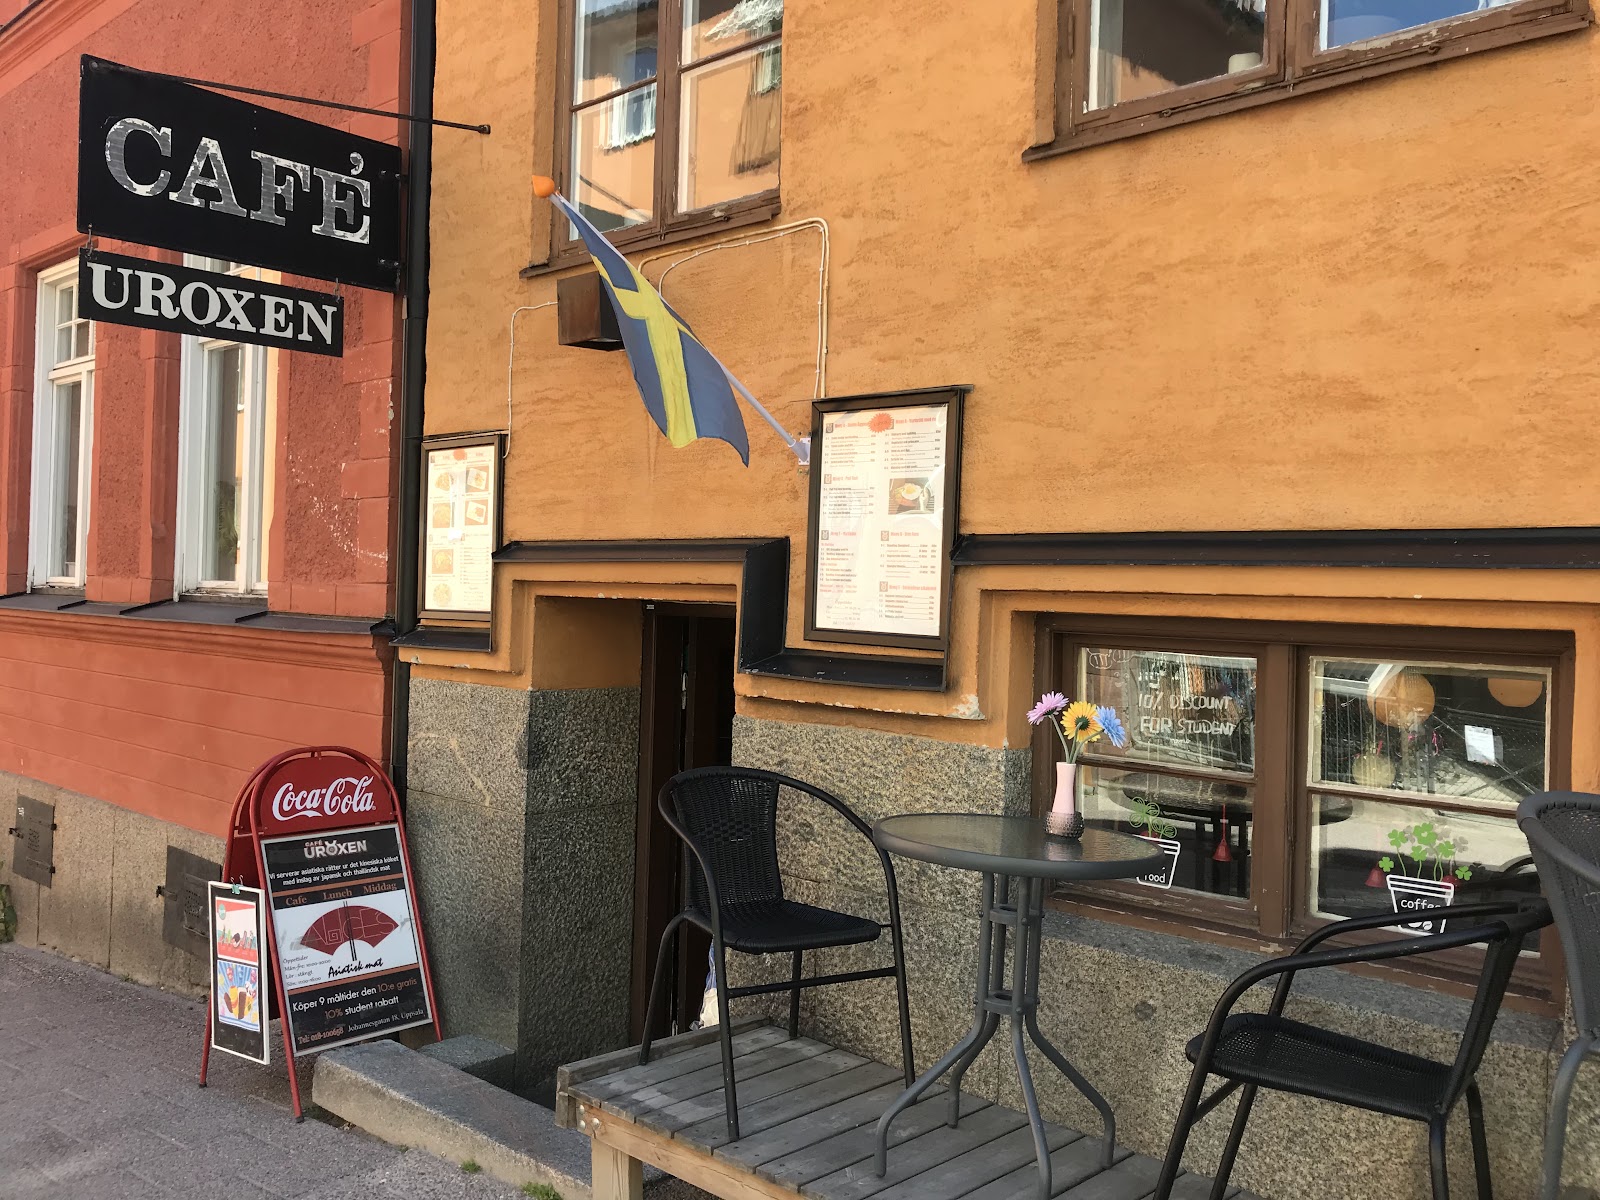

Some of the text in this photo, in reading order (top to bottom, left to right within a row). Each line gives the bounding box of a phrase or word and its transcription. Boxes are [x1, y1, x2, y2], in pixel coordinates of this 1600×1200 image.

[104, 117, 371, 245] CAFÉ
[86, 262, 338, 345] UROXEN
[1138, 690, 1233, 711] 10% DISCOUNT
[1140, 715, 1237, 736] FOR STUDENT
[272, 775, 375, 821] Coca-Cola
[304, 840, 367, 858] UROXEN
[305, 839, 323, 847] CAFÉ
[276, 870, 300, 879] serverar
[301, 866, 325, 875] asiatiska
[325, 864, 341, 872] rätter
[359, 858, 383, 867] kinesiska
[383, 856, 399, 864] köket
[296, 876, 312, 885] inslag
[321, 872, 342, 882] japansk
[342, 869, 353, 877] och
[353, 866, 379, 876] thailändsk
[379, 864, 391, 872] mat
[1144, 869, 1167, 884] ood
[322, 888, 353, 900] Lunch
[362, 881, 398, 894] Middag
[327, 957, 384, 979] Asiatisk mat
[319, 997, 325, 1006] 9
[326, 990, 360, 1005] måltider
[361, 987, 377, 996] den
[377, 983, 394, 993] 10:e
[396, 977, 418, 991] gratis
[324, 996, 399, 1020] 10% student rabatt
[400, 1009, 424, 1020] Uppsala
